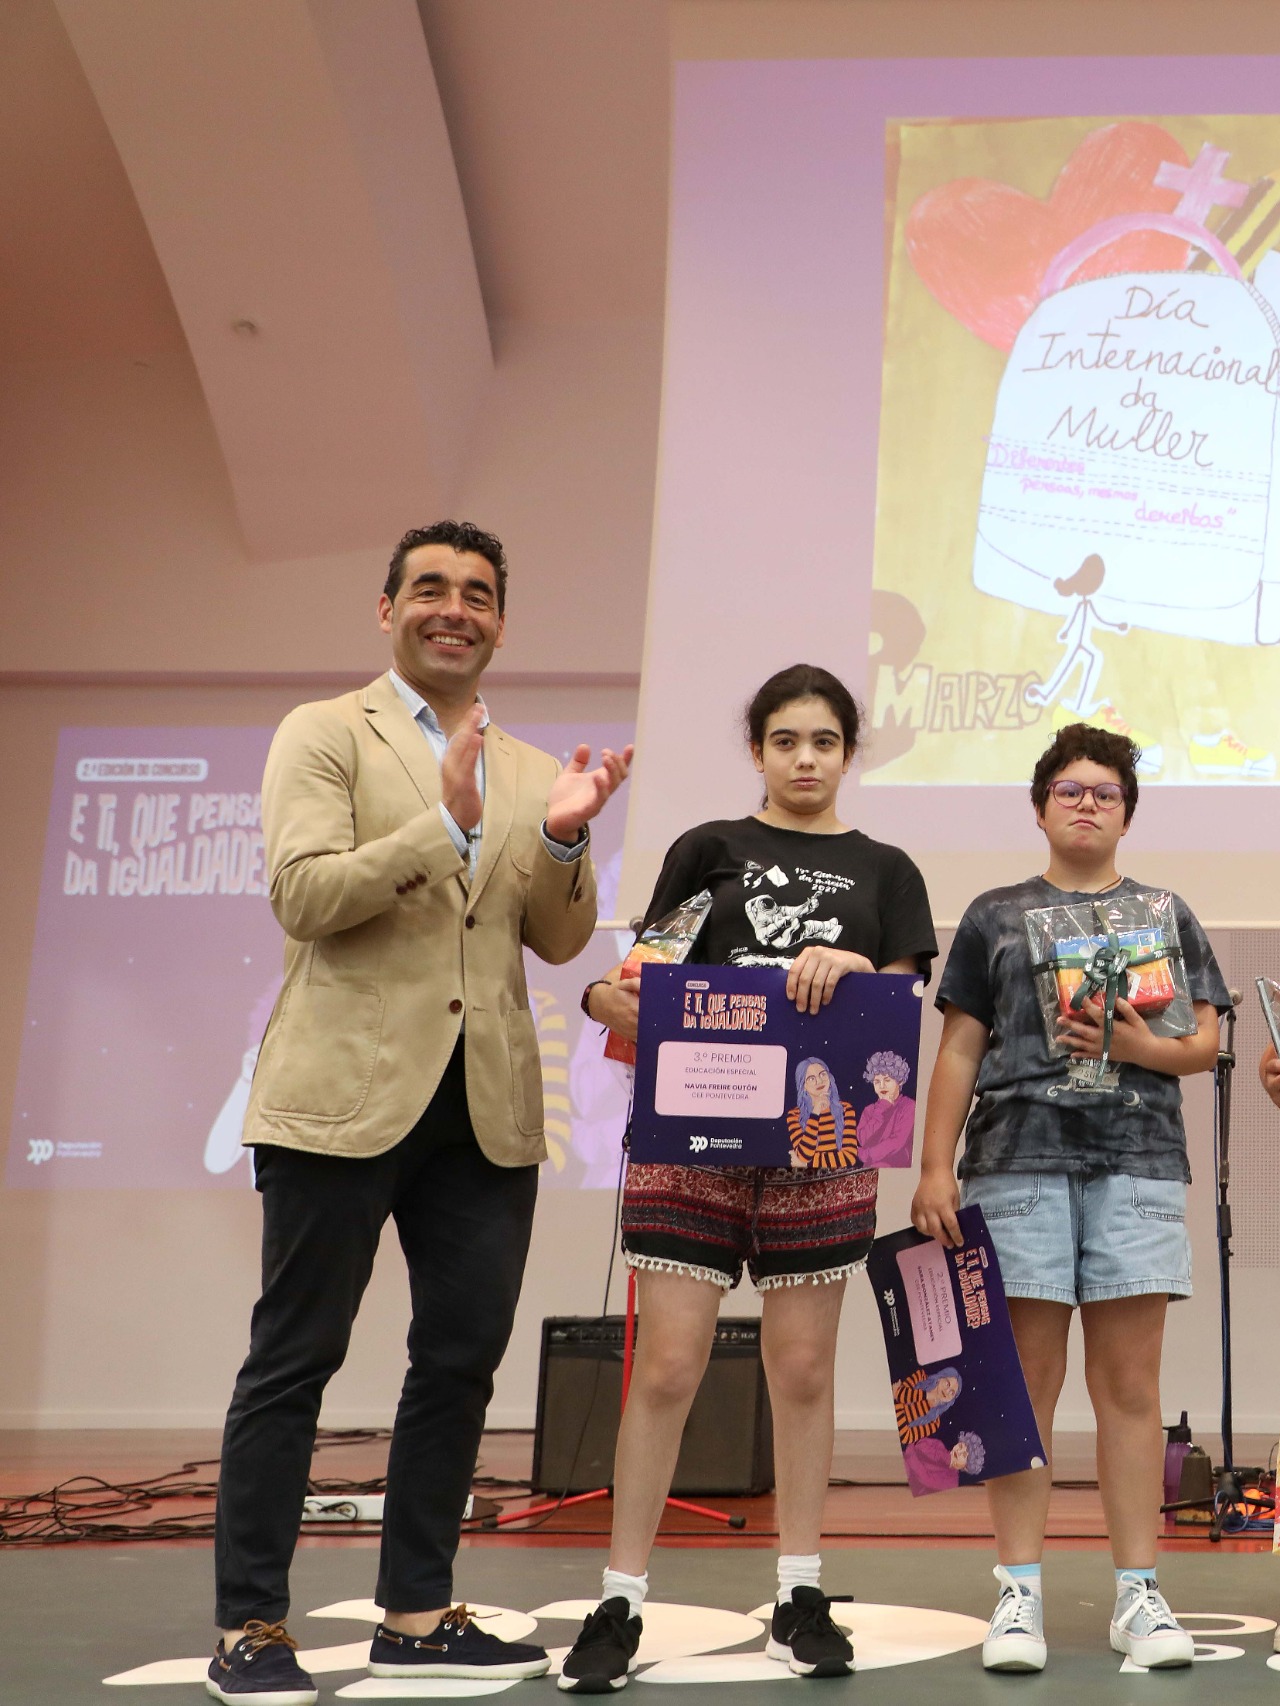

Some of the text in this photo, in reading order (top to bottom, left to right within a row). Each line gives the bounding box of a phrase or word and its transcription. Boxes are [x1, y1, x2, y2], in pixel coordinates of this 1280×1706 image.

[1114, 285, 1209, 328] Día
[1022, 319, 1280, 395] Internacional
[1120, 378, 1163, 412] da
[1047, 405, 1214, 467] Muller
[871, 662, 1045, 734] MARZO
[70, 793, 89, 843] E
[130, 793, 181, 856] QUE
[188, 793, 262, 834] PENSA
[64, 850, 98, 896] DA
[683, 1007, 767, 1032] DA IGUALDADE?
[684, 992, 691, 1011] E
[708, 992, 727, 1016] QUE
[730, 993, 767, 1011] PENSAS
[685, 1066, 757, 1076] EDUCACIÓN ESPECIAL
[710, 1053, 752, 1064] PREMIO
[941, 1287, 951, 1324] PREMIO
